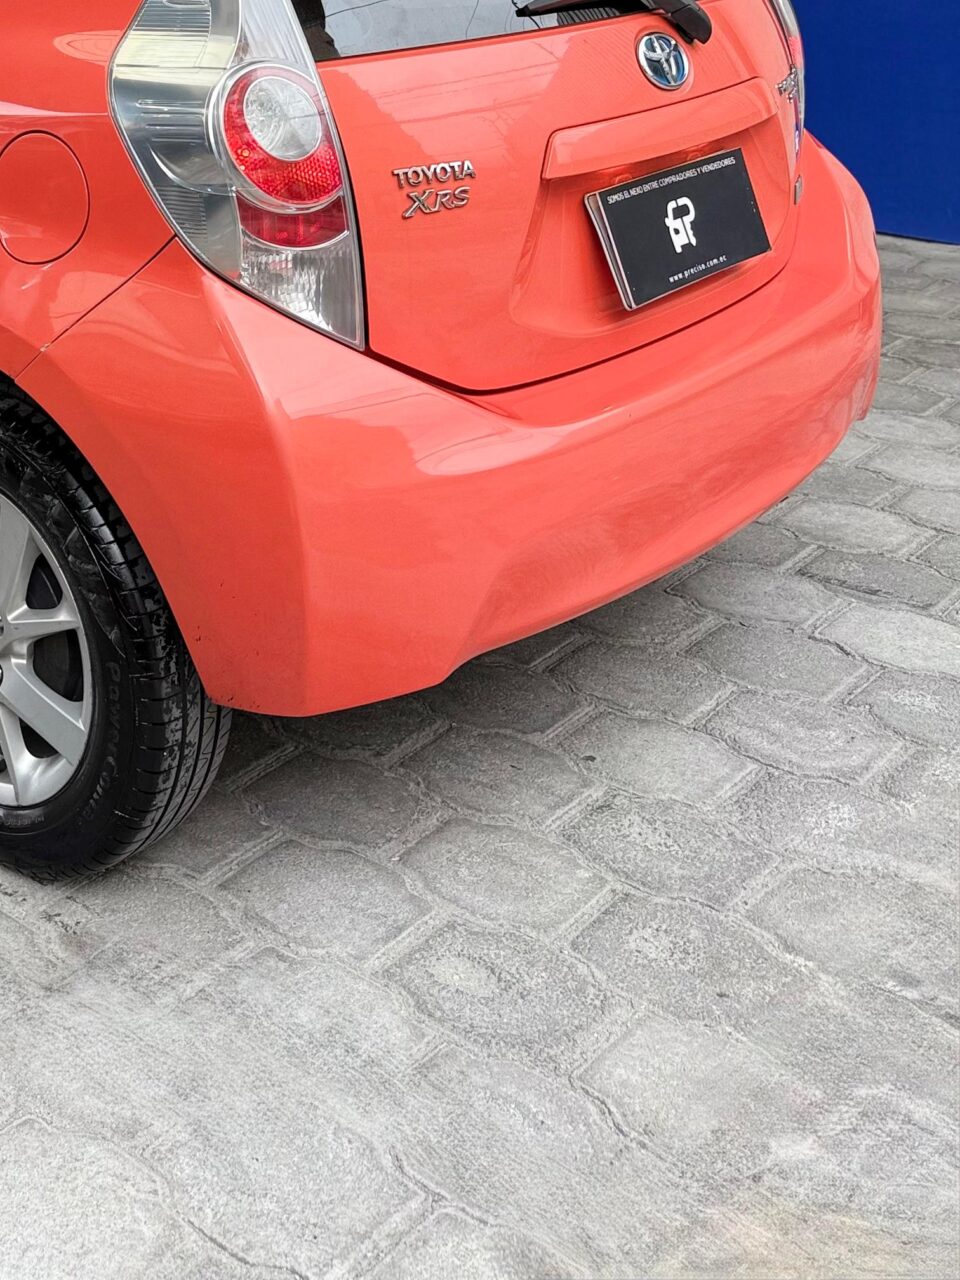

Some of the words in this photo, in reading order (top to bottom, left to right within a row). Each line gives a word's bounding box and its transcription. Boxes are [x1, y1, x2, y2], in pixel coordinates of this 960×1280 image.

[392, 160, 476, 190] TOYOTA
[607, 192, 624, 204] SOMOS
[642, 181, 659, 193] ENTRE
[659, 169, 697, 186] COMPRADORES
[701, 157, 735, 173] VENDEDORES
[401, 186, 471, 220] XRS
[669, 255, 727, 282] www.preciso.com.ec
